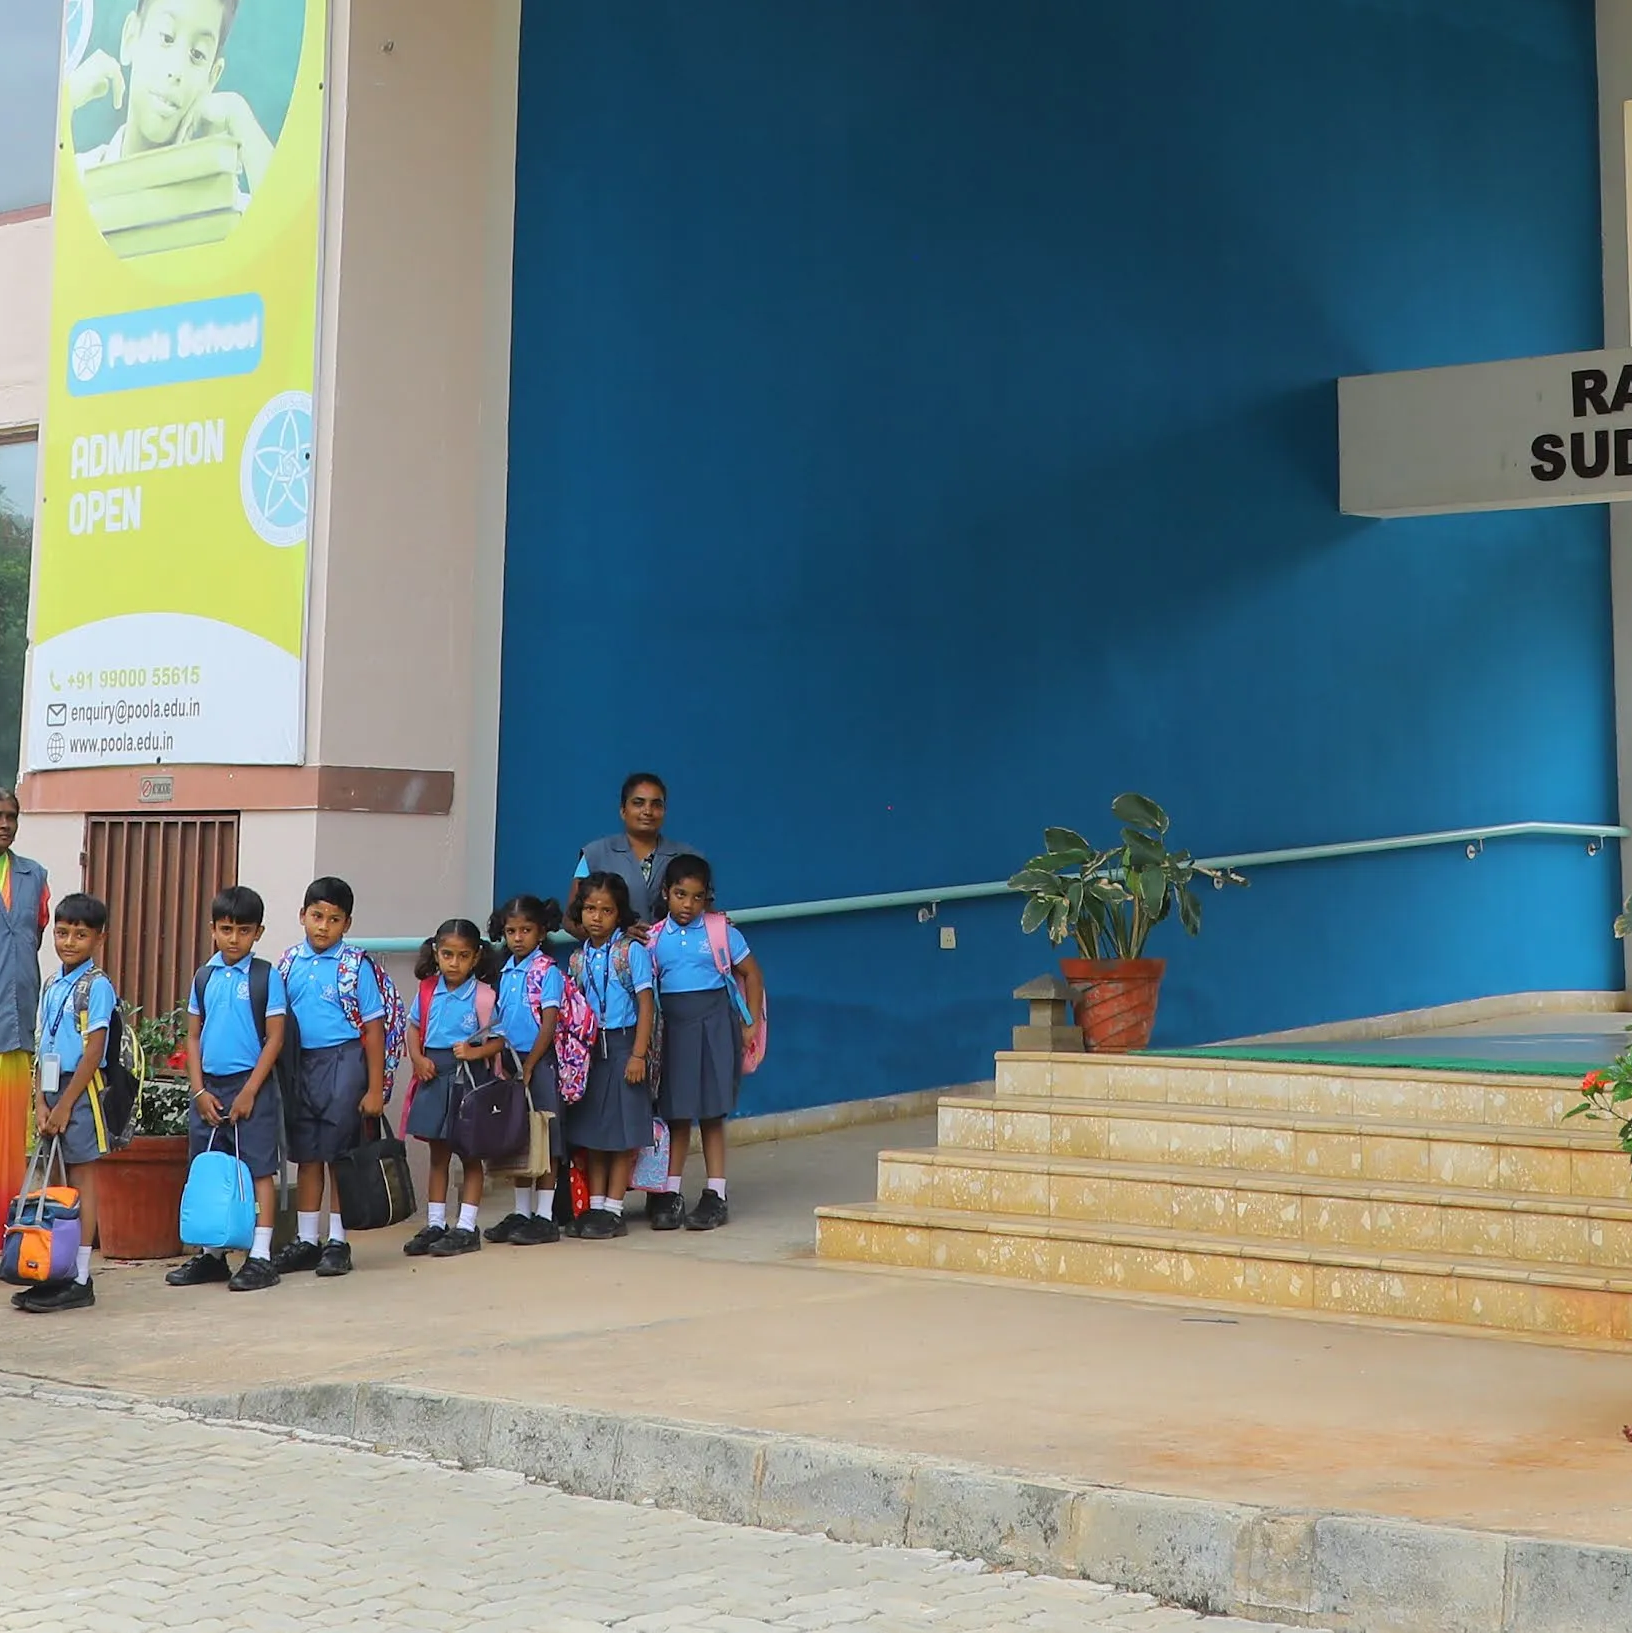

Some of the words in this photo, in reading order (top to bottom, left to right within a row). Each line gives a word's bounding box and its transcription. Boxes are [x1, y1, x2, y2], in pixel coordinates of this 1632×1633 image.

[70, 418, 225, 480] ADMISSION
[68, 485, 142, 536] OPEN
[67, 671, 94, 690] +91
[99, 668, 147, 688] 99000
[151, 665, 201, 687] 55615
[71, 697, 201, 726] enquiry@poola.edu.in
[69, 731, 174, 757] www.poola.edu.in
